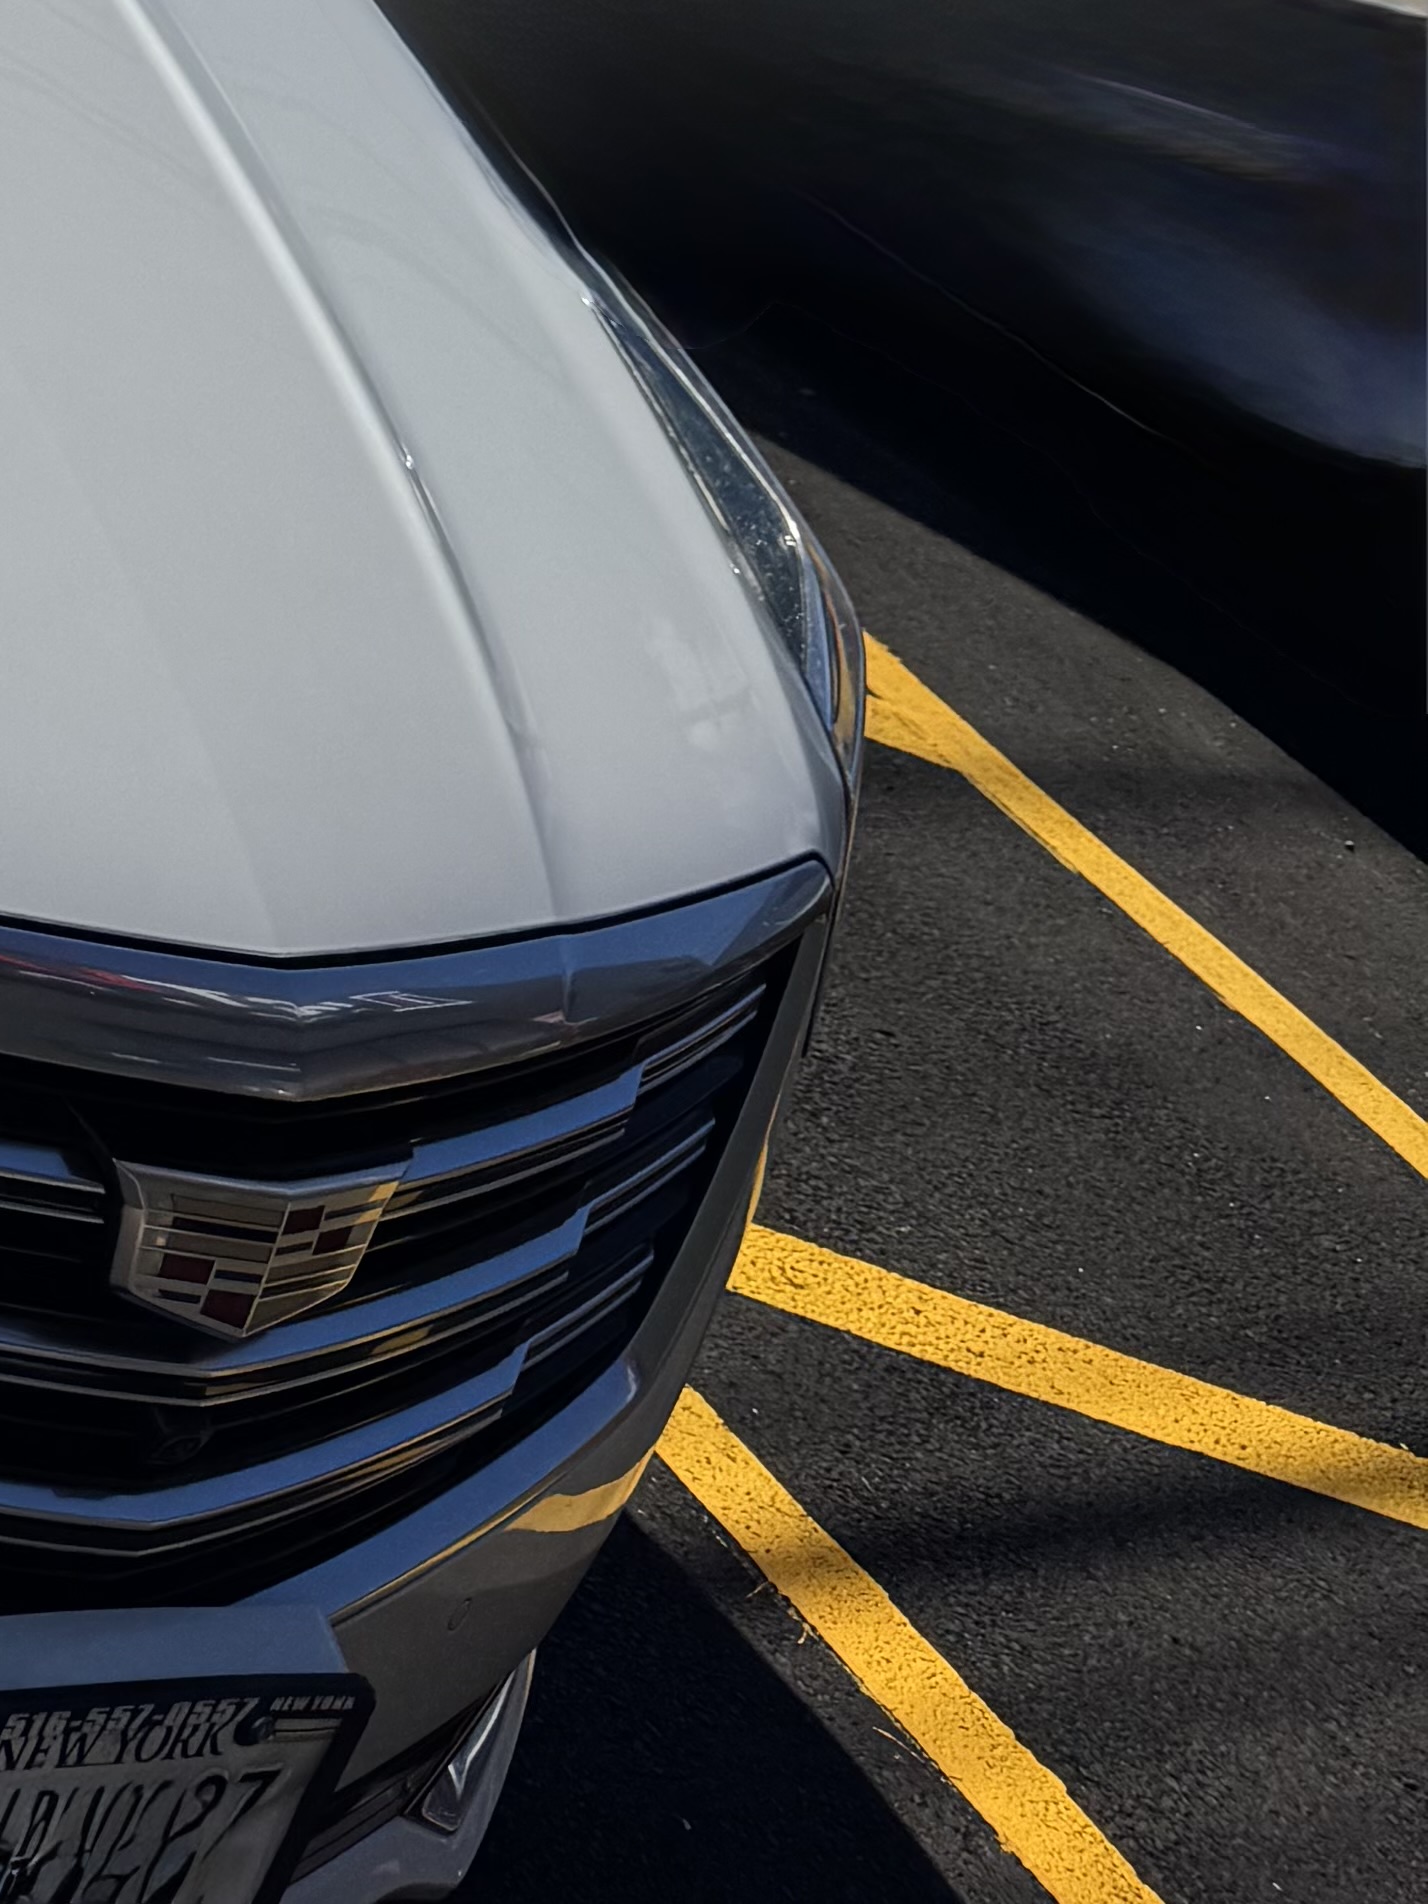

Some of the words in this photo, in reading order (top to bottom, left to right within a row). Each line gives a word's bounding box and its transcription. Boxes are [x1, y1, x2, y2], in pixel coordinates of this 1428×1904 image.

[270, 1697, 312, 1712] NEW
[311, 1695, 355, 1710] YORK
[113, 1716, 234, 1762] YORK
